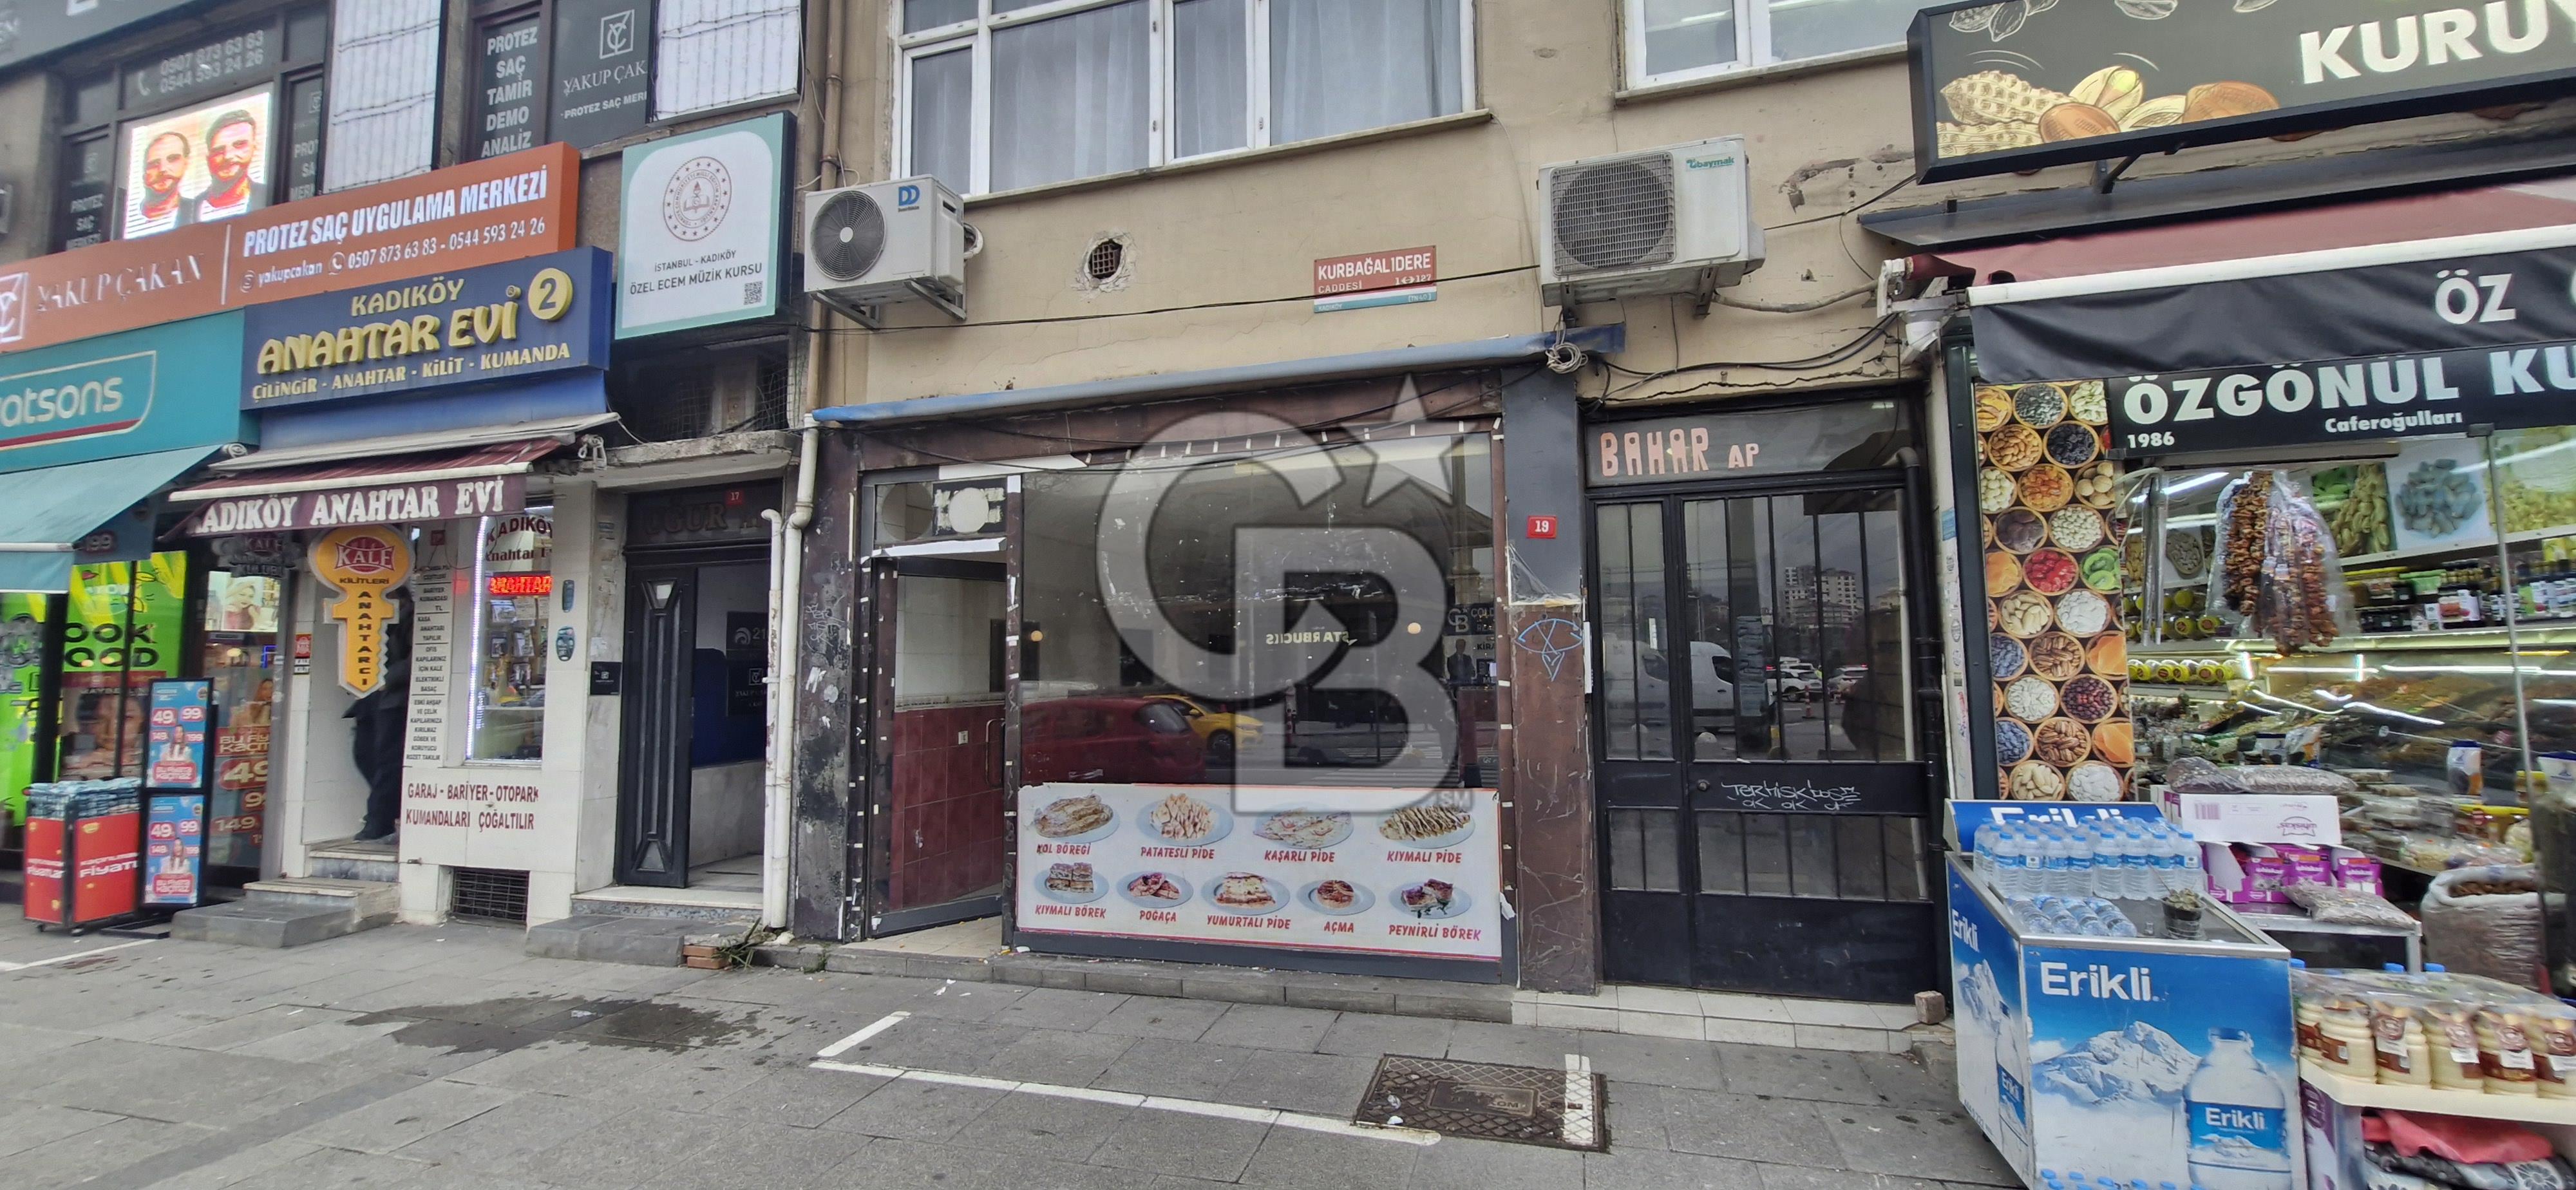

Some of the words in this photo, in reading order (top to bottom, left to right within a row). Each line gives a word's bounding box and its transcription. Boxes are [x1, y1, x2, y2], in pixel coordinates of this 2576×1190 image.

[487, 27, 537, 56] PROTEZ
[496, 55, 526, 80] SAÇ
[487, 77, 532, 105] TAMİR
[563, 71, 611, 96] YAKUP
[602, 97, 622, 113] SAÇ
[486, 106, 529, 131] DEMO
[482, 129, 532, 158] ANALİZ
[243, 218, 307, 257] PROTEZ
[311, 212, 348, 245] SAÇ
[352, 187, 455, 236] UYGULAMA
[460, 164, 547, 215] MERKEZİ
[258, 261, 323, 287] yakupcakan
[348, 248, 375, 269] 0507
[379, 243, 401, 263] 873
[404, 241, 420, 260] 63
[422, 238, 437, 256] 83
[449, 231, 480, 251] 0544
[483, 225, 506, 244] 593
[510, 220, 526, 239] 24
[529, 217, 545, 235] 26
[654, 258, 694, 272] İSTANBUL
[701, 249, 736, 265] KADIKÖY
[630, 281, 655, 294] ÖZEL
[658, 276, 686, 290] ECEM
[689, 269, 722, 285] MÜZİK
[725, 262, 762, 279] KURSU
[1318, 252, 1431, 281] KURBAĞALIDERE
[350, 276, 465, 317] KADIKÖY
[1318, 279, 1363, 294] CADDESİ
[2434, 269, 2517, 325] ÖZ
[257, 314, 442, 375] ANAHTAR
[448, 285, 520, 349] EVİ
[538, 277, 558, 312] 2
[332, 363, 406, 392] ANAHTAR
[480, 343, 570, 370] KUMANDA
[0, 376, 124, 428] atsons
[2123, 355, 2460, 425] ÖZGÖNÜL
[2127, 431, 2175, 449] 1986
[2325, 410, 2463, 433] Caferoğulları
[1600, 426, 1709, 477] BAHAR
[1728, 442, 1759, 469] AP
[310, 485, 440, 525] ANAHTAR
[455, 476, 505, 515] EVİ
[730, 491, 740, 501] 17
[1535, 519, 1549, 533] 19
[337, 545, 394, 571] KALE
[64, 622, 157, 644] OOK
[357, 591, 372, 686] ANAHTARCI
[65, 647, 159, 667] OOD
[245, 791, 266, 808] 9
[408, 782, 438, 799] GARAJ
[406, 808, 470, 827] KUMANDALARI
[478, 809, 535, 833] ÇOĞALTILIR
[1990, 807, 2125, 829] Erili
[1036, 843, 1053, 855] KOL
[1141, 845, 1189, 859] PATATESLİ
[1191, 845, 1215, 860] PİDE
[1264, 849, 1307, 864] KAŞARLI
[1311, 848, 1335, 863] PİDE
[1387, 850, 1432, 863] KIYMALI
[1435, 849, 1463, 864] PİDE
[1034, 904, 1072, 917] KIYMALI
[1074, 905, 1107, 919] BÖREK
[1139, 909, 1177, 924] POĞAÇA
[1207, 914, 1263, 929] YUMURTALI
[1267, 915, 1291, 929] PİDE
[1323, 921, 1354, 936] AÇMA
[1388, 921, 1439, 939] PEYNİRLİ
[1443, 925, 1481, 941] BÖREK
[1951, 908, 1980, 953] Erikli
[2040, 961, 2152, 1002] Erikli
[2204, 1107, 2266, 1131] Erikli
